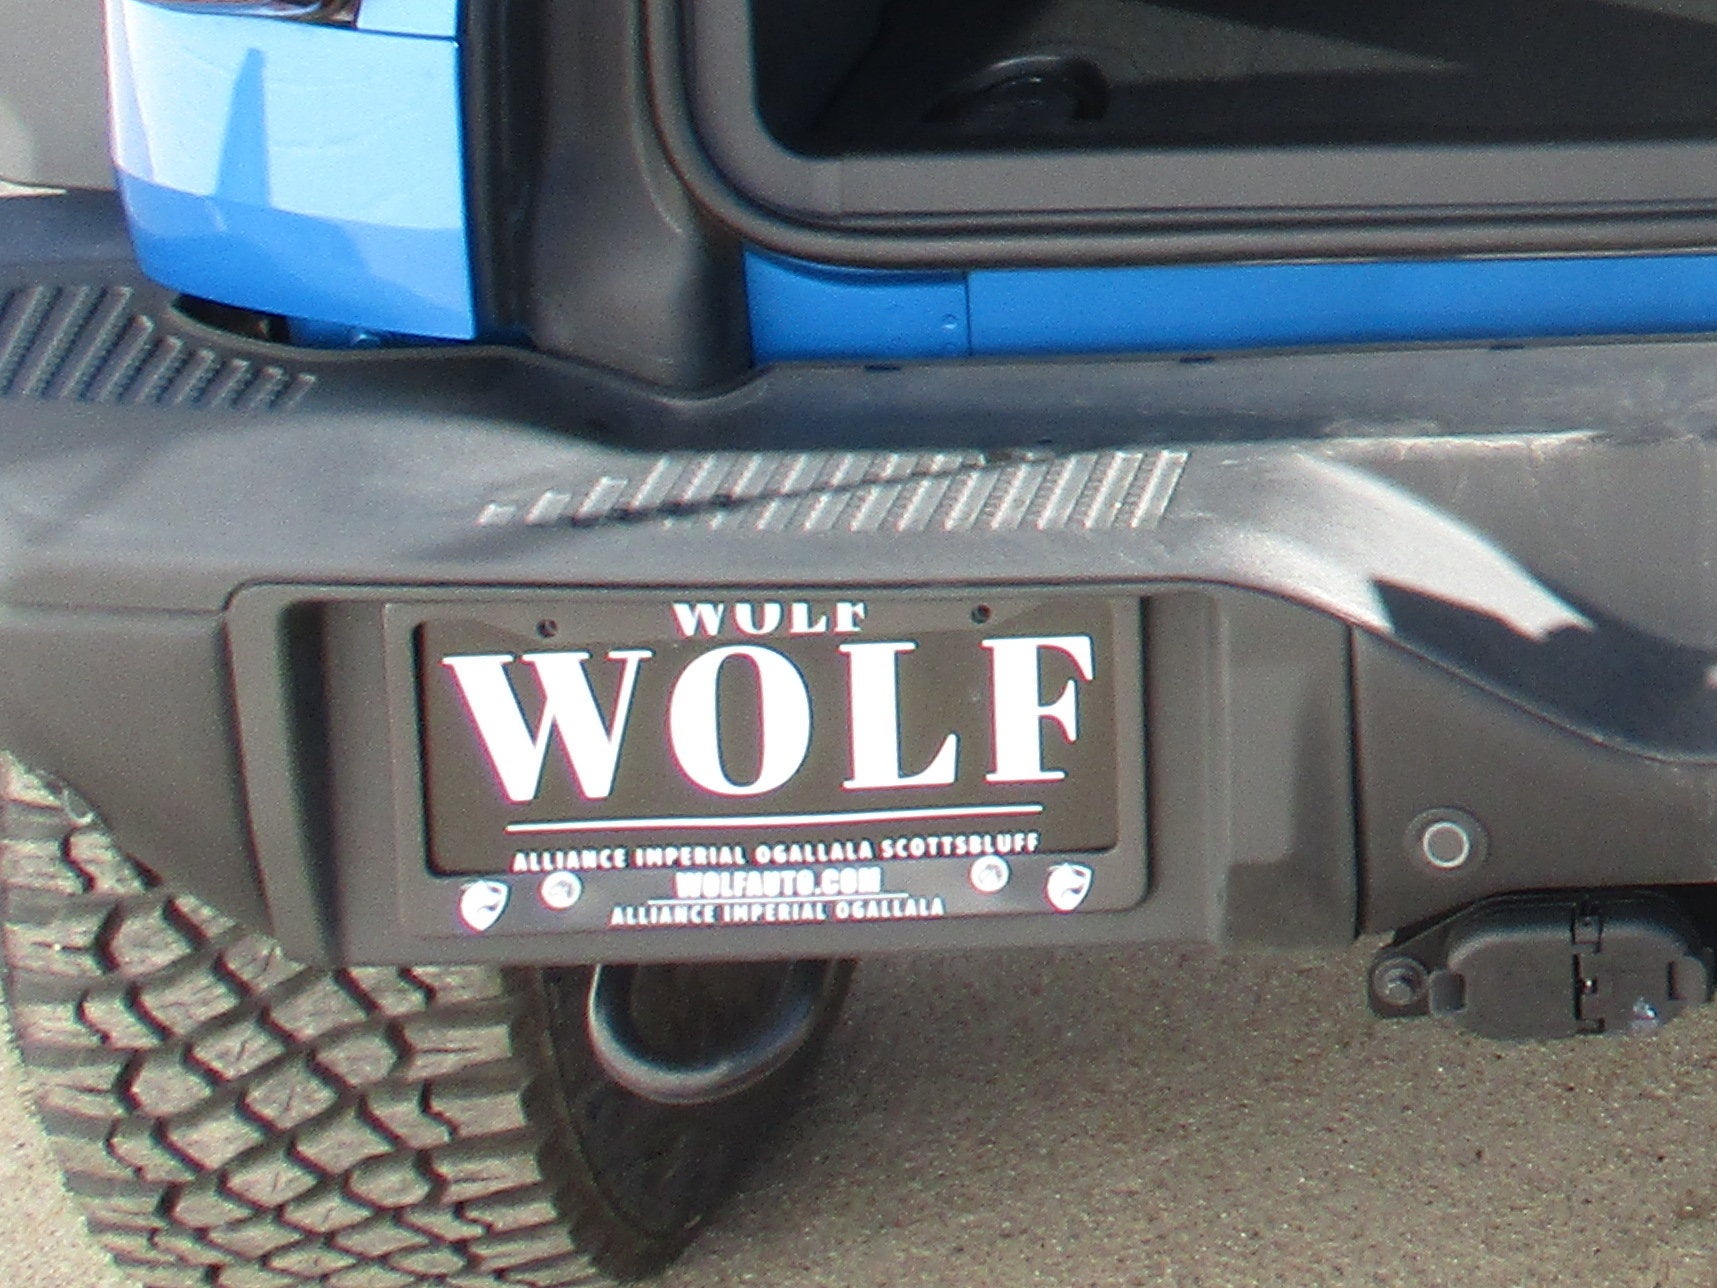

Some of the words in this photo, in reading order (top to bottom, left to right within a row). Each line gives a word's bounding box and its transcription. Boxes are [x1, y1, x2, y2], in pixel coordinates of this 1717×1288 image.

[672, 602, 865, 637] WOLF
[442, 635, 1094, 803] WOLF
[511, 848, 628, 873] ALLIANCE
[633, 845, 747, 867] IMPERIAL
[754, 839, 873, 864] OGALLALA
[879, 832, 1041, 858] SCOTTSBLUFF
[675, 867, 882, 899] WOLFAUTO.COM
[610, 904, 717, 926] ALLIANCE
[722, 901, 828, 924] IMPERIAL
[833, 898, 945, 921] OGALLALA
